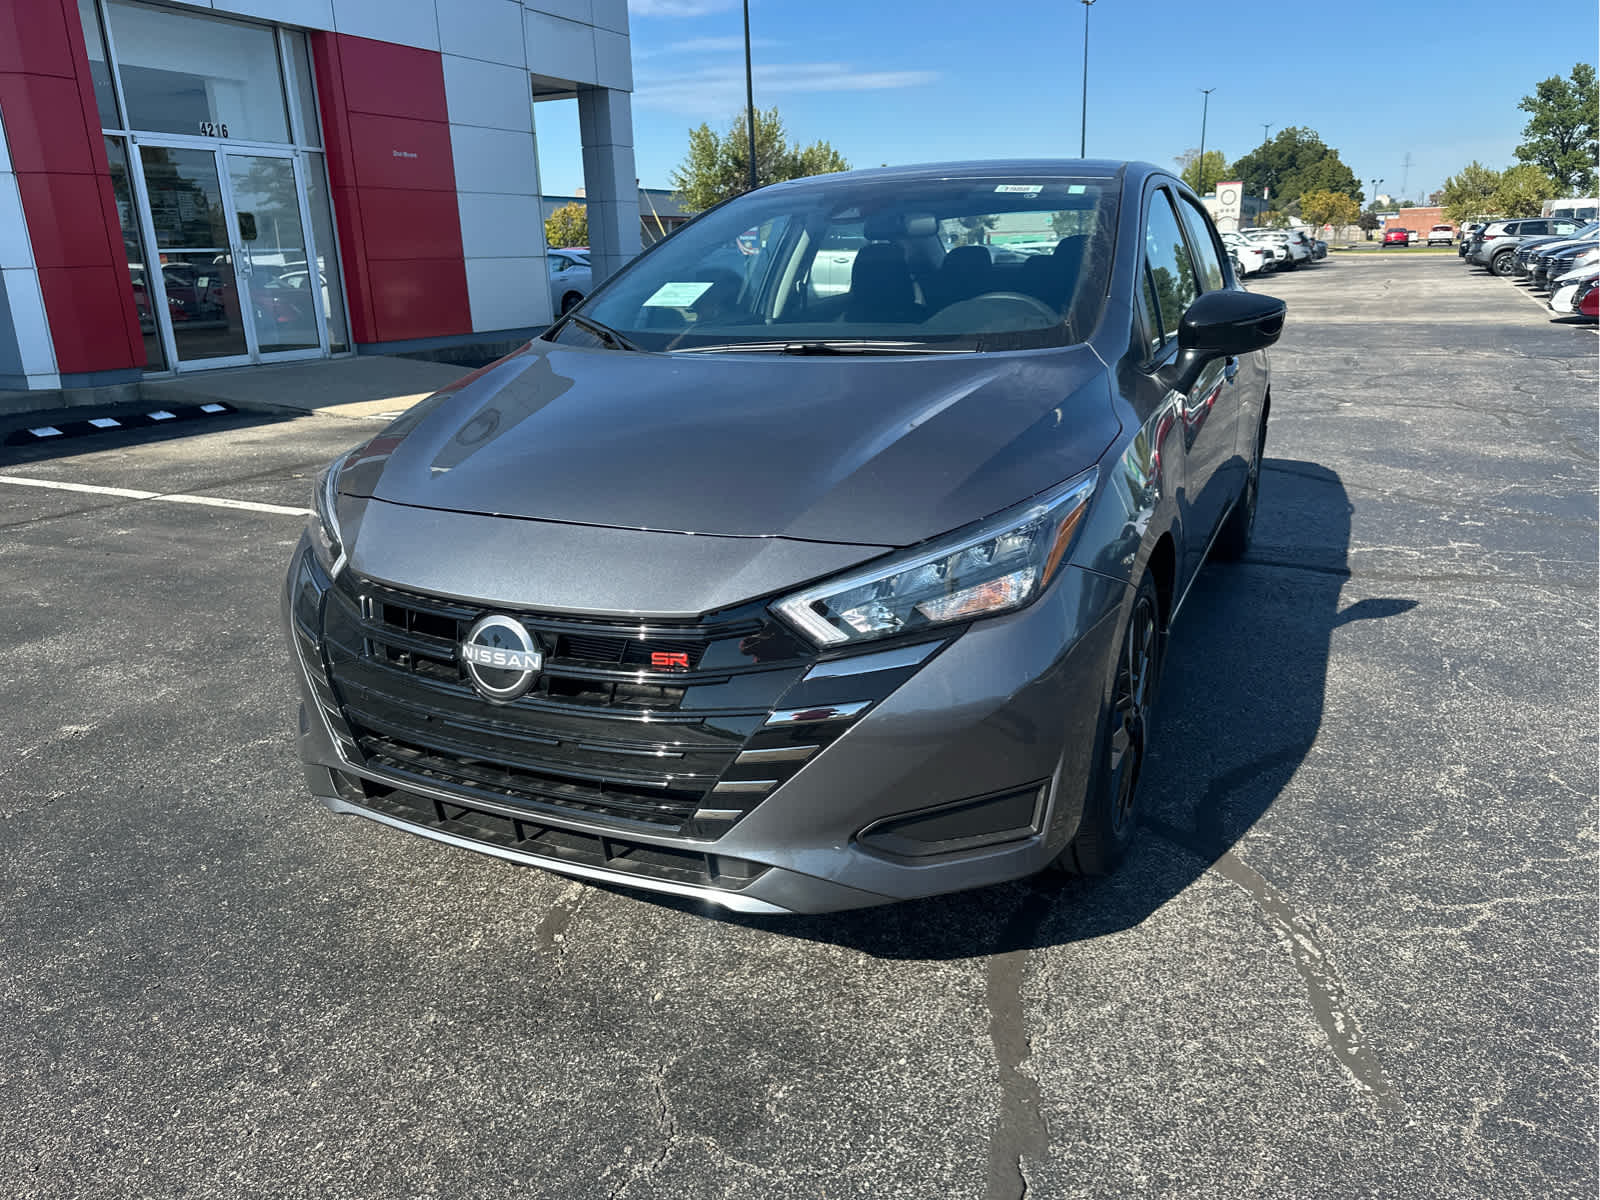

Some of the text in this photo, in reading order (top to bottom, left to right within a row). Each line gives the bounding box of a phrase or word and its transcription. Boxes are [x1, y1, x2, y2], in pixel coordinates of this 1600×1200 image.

[201, 122, 228, 138] 4216
[462, 645, 540, 669] NISSAN
[651, 651, 689, 667] SR
